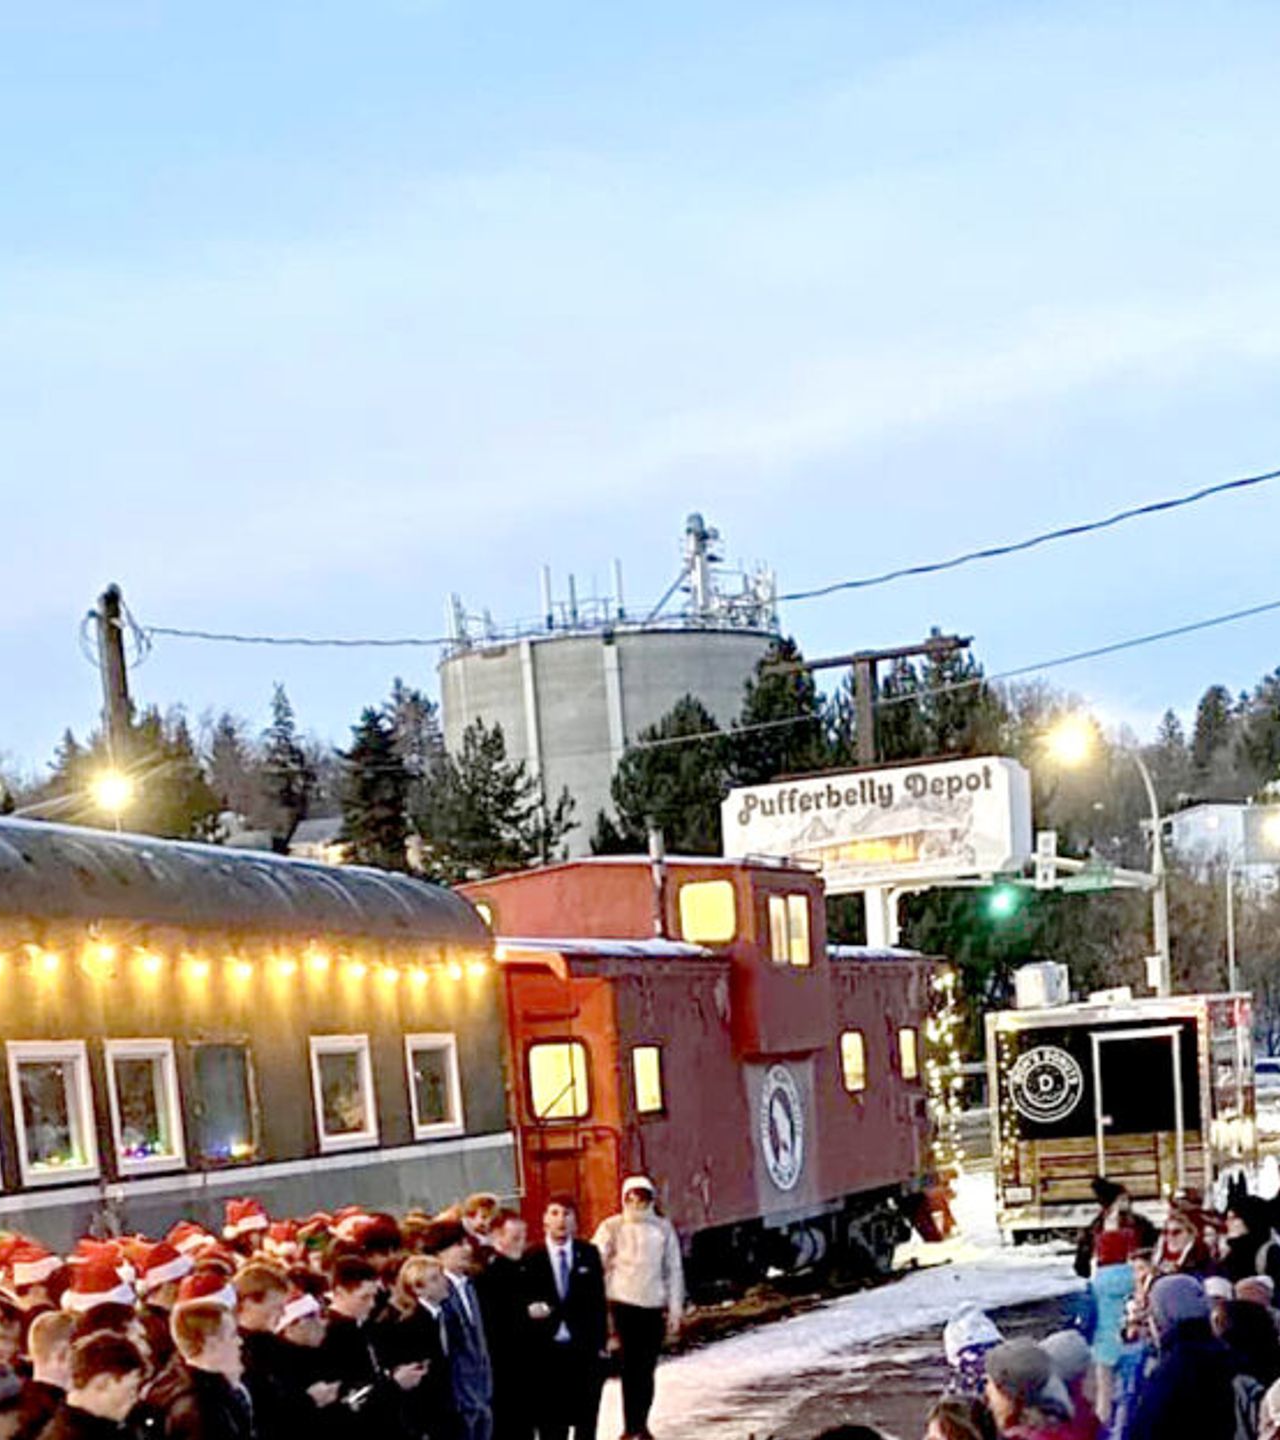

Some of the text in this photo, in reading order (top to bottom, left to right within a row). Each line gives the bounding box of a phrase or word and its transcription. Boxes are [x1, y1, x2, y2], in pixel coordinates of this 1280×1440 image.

[737, 764, 993, 826] Pufferbelly Depot
[1038, 1074, 1054, 1093] D
